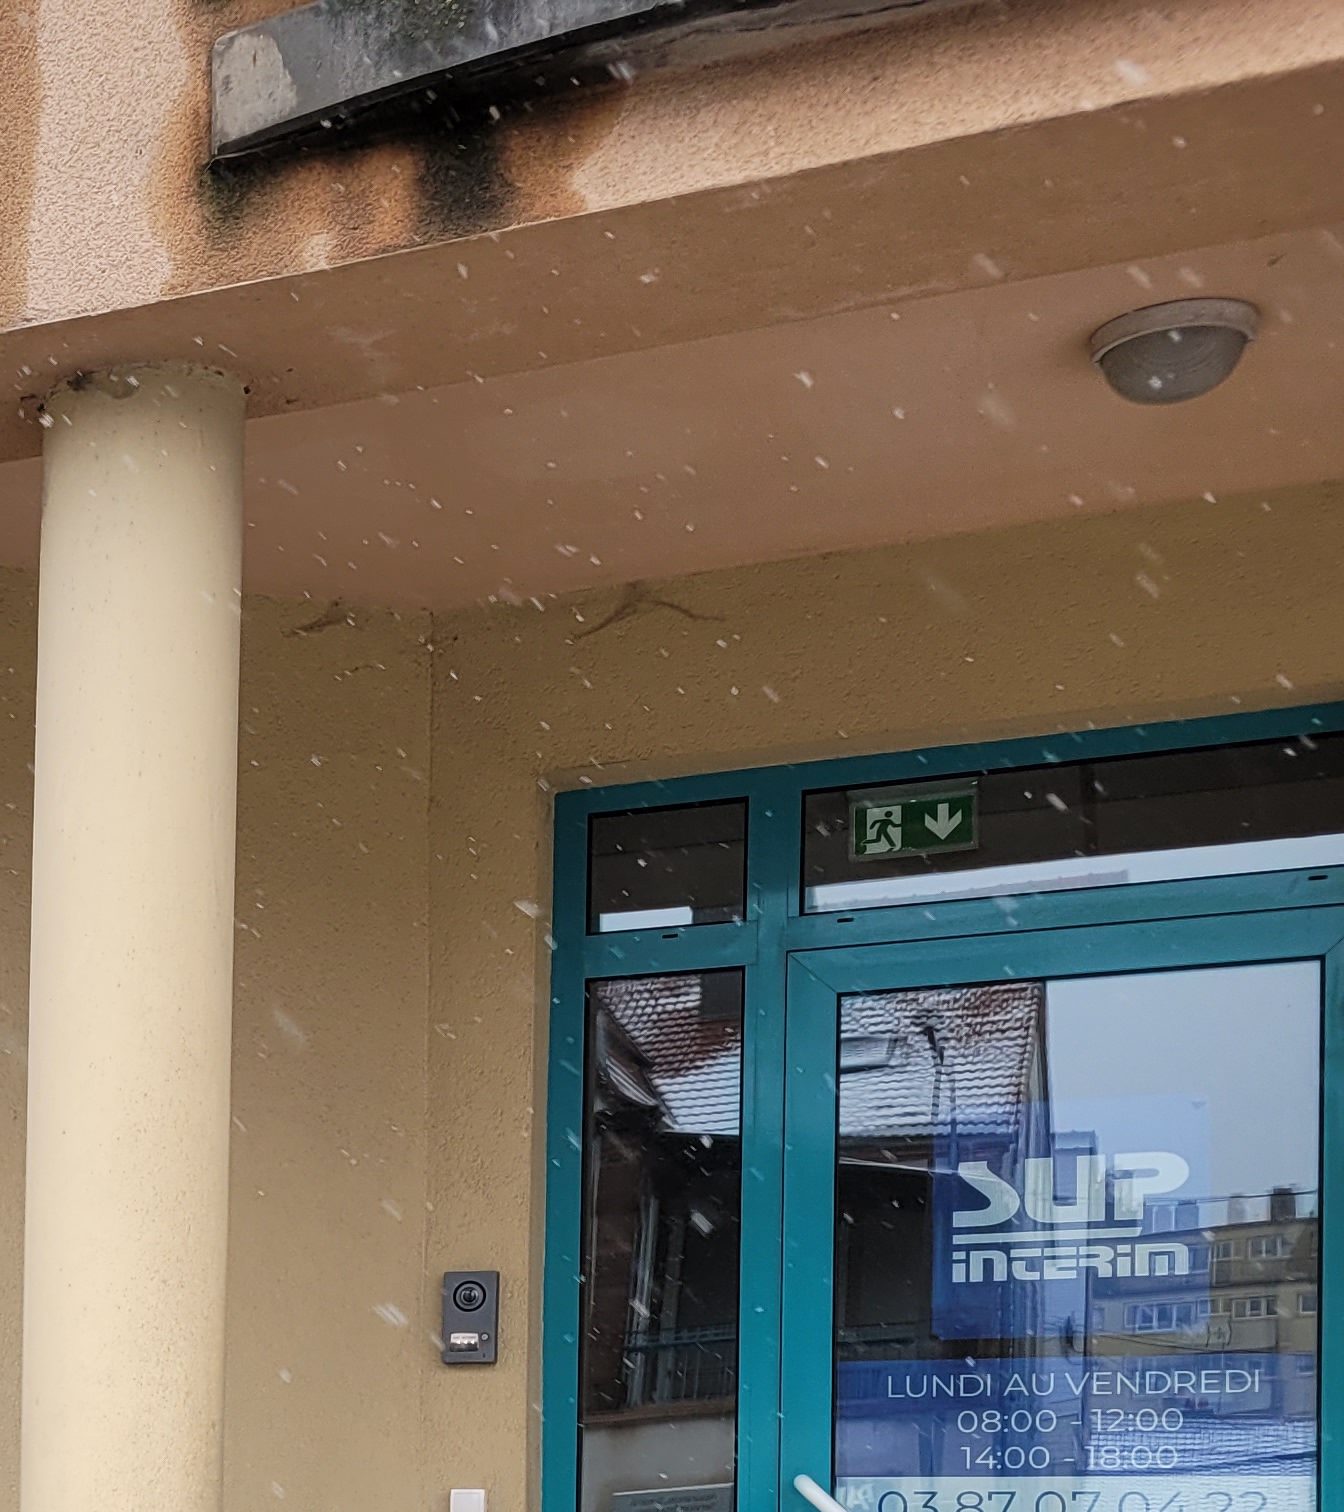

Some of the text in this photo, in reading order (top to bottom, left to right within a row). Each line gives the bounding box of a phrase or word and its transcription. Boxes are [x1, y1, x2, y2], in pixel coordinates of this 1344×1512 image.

[952, 1151, 1190, 1228] SUP
[886, 1369, 1261, 1399] LUNDI AU VENDREDI
[956, 1408, 1058, 1434] 08:00
[1091, 1407, 1185, 1433] 12:00
[960, 1445, 1051, 1471] 14:00
[1087, 1444, 1179, 1470] 18:00
